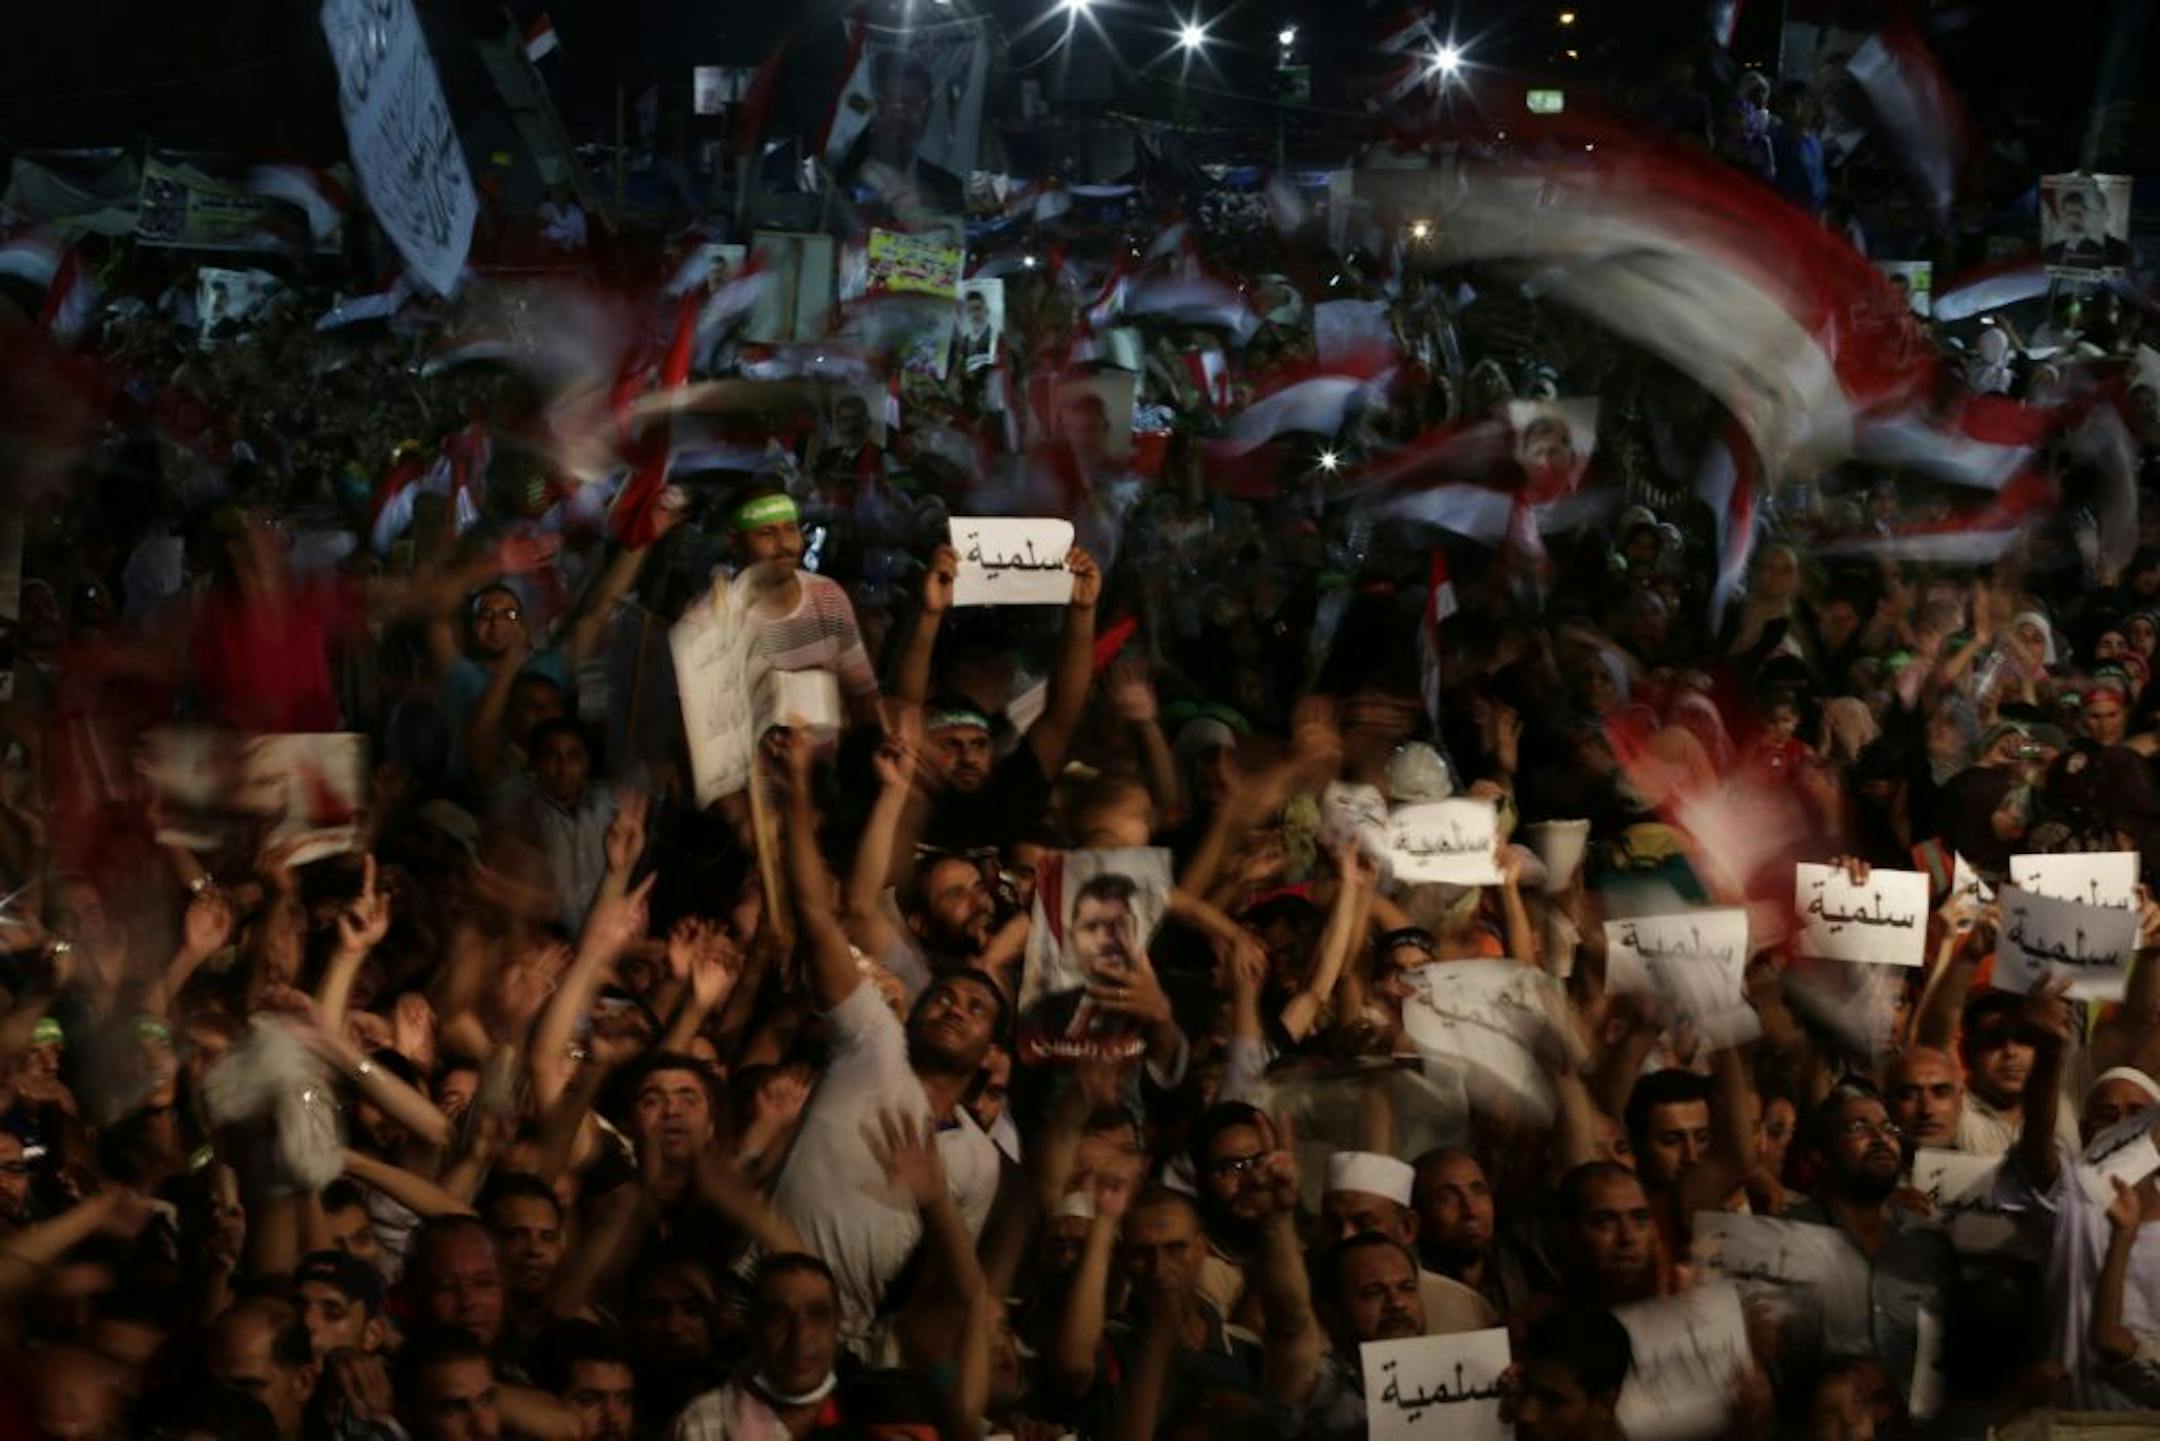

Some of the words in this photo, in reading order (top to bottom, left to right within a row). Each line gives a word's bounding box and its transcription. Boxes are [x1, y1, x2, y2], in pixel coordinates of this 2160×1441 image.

[967, 531, 1063, 580] سلمية
[1808, 880, 1914, 934] سلمية
[2008, 907, 2118, 968] سلمية
[1382, 1359, 1503, 1423] سلمية
